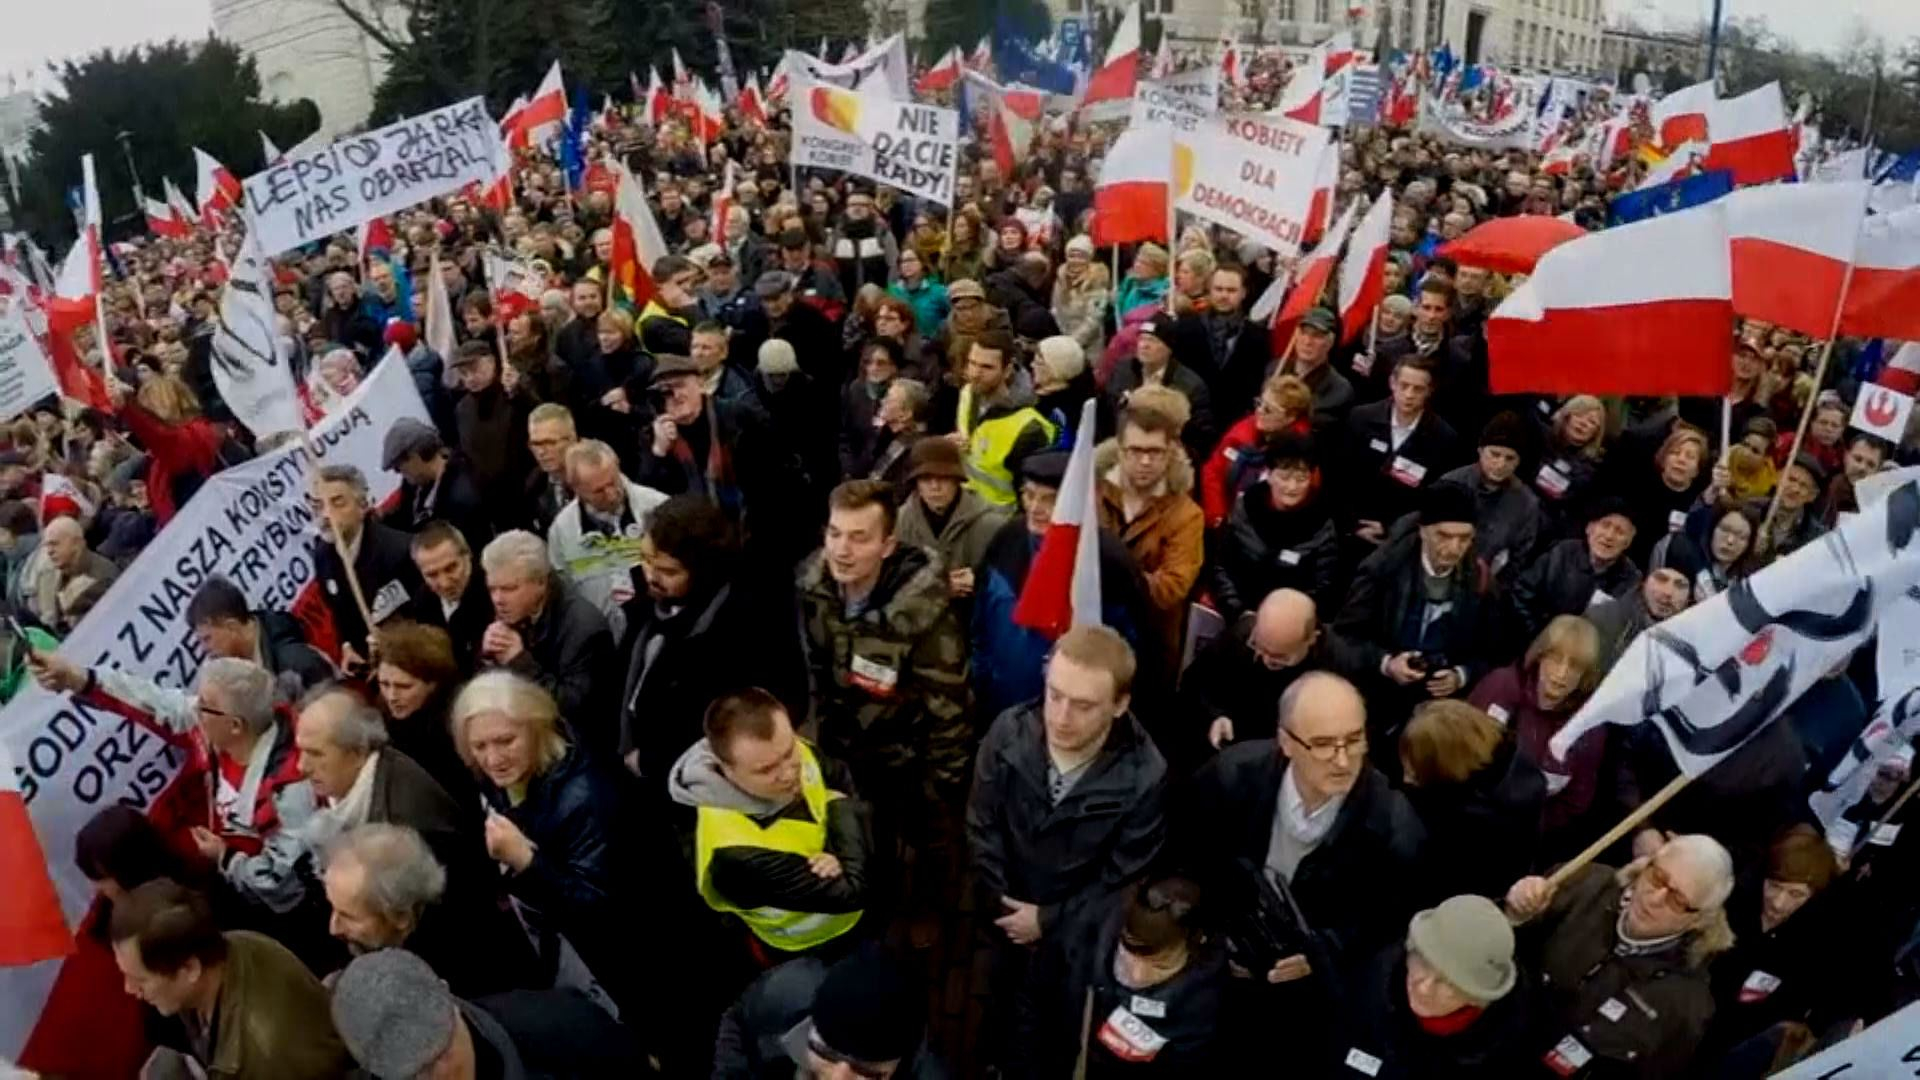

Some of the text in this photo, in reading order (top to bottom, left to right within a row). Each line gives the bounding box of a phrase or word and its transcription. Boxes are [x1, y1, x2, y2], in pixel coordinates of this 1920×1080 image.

[897, 106, 938, 135] NIE
[1225, 117, 1306, 156] KOBIETY
[872, 131, 953, 167] DACIE
[872, 153, 951, 199] RADY!
[1239, 160, 1277, 191] DLA
[295, 184, 350, 238] NAS
[117, 620, 156, 663] Z
